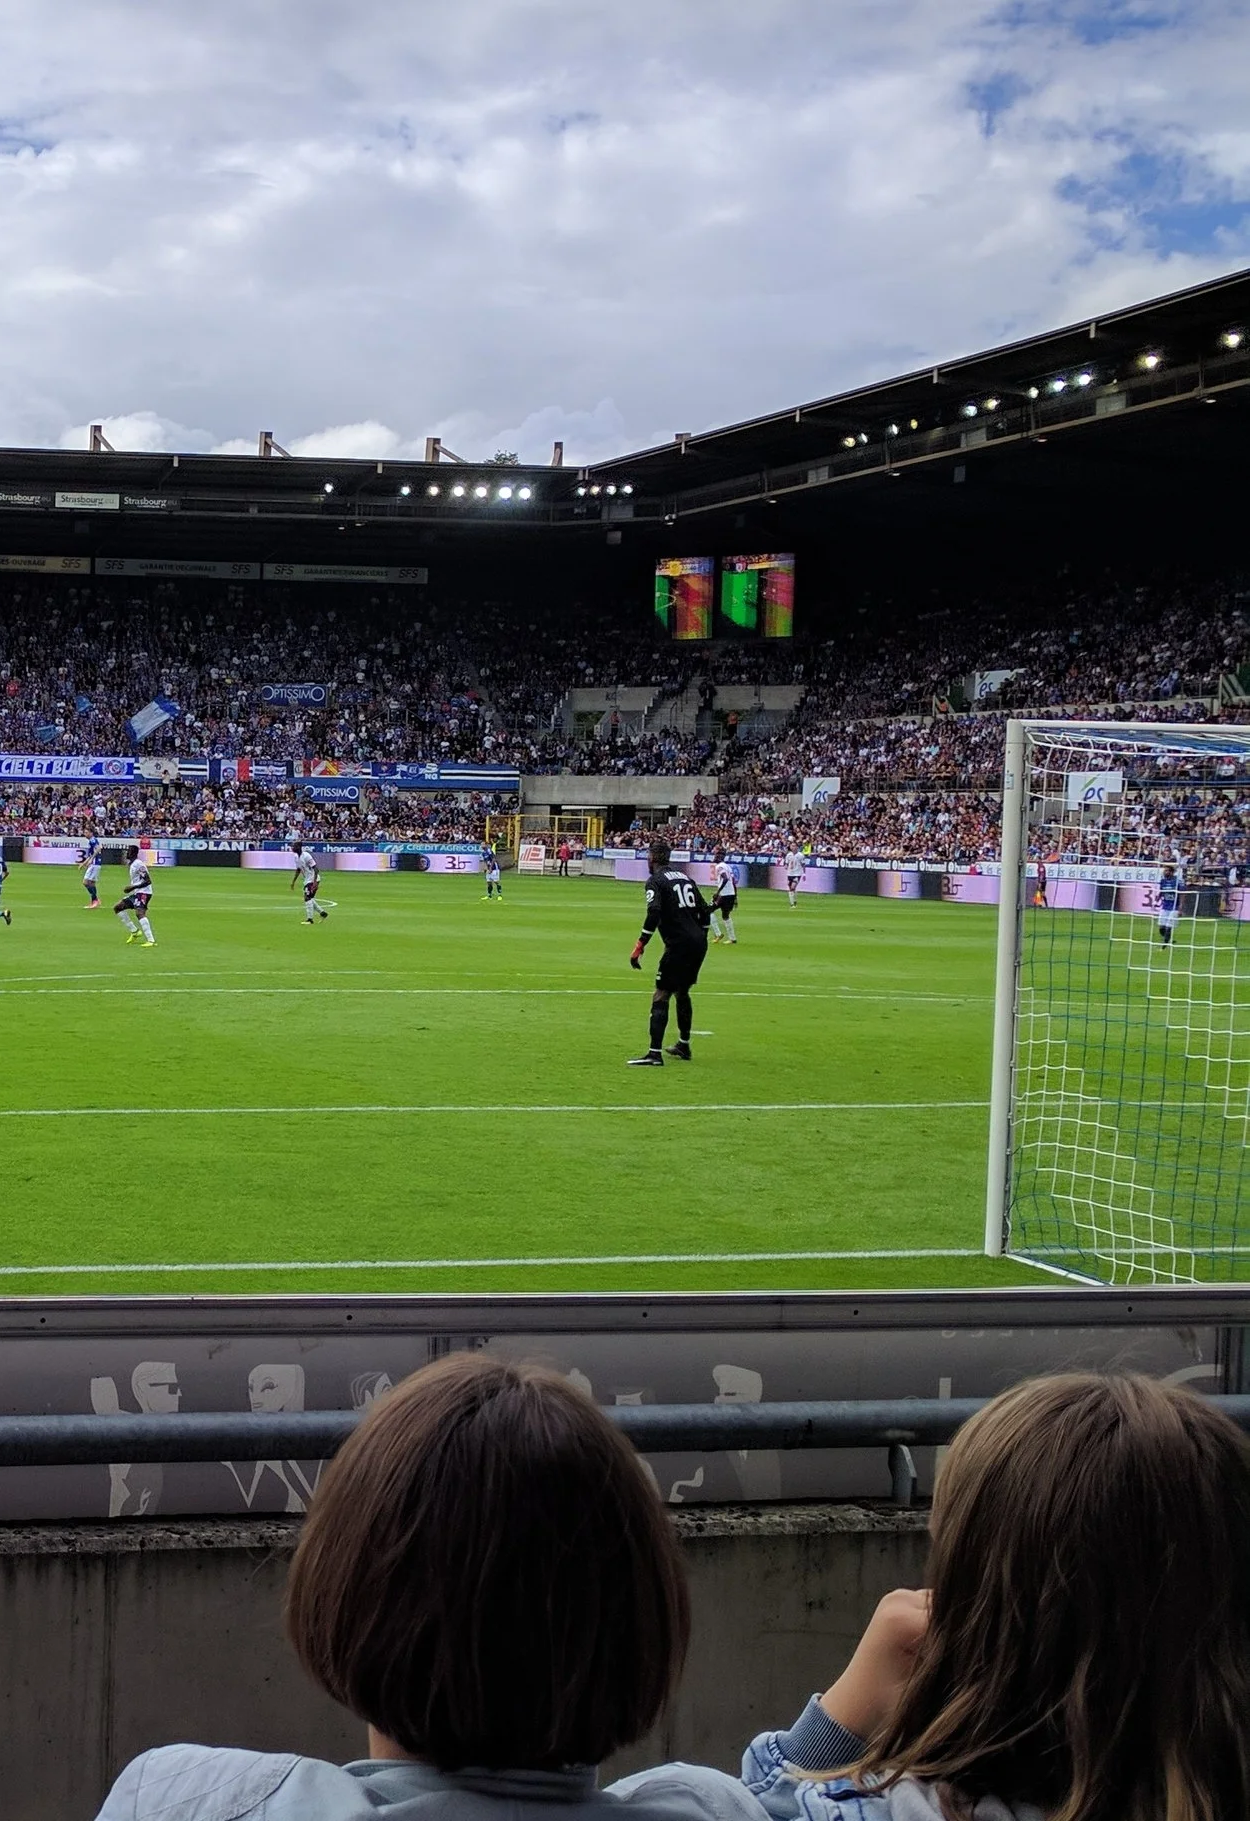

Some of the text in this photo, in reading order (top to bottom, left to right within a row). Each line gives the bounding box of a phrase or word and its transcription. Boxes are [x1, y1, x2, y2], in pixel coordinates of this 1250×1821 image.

[61, 558, 81, 569] SFS
[104, 560, 125, 570] SFS
[231, 563, 251, 574] SFS
[274, 565, 295, 576] SFS
[399, 568, 419, 579] SFS
[261, 685, 325, 702] OPTISSIMO
[1, 758, 33, 775] CIEL
[34, 759, 53, 775] ET
[304, 785, 359, 799] OPTISSIMO
[672, 883, 696, 909] 16
